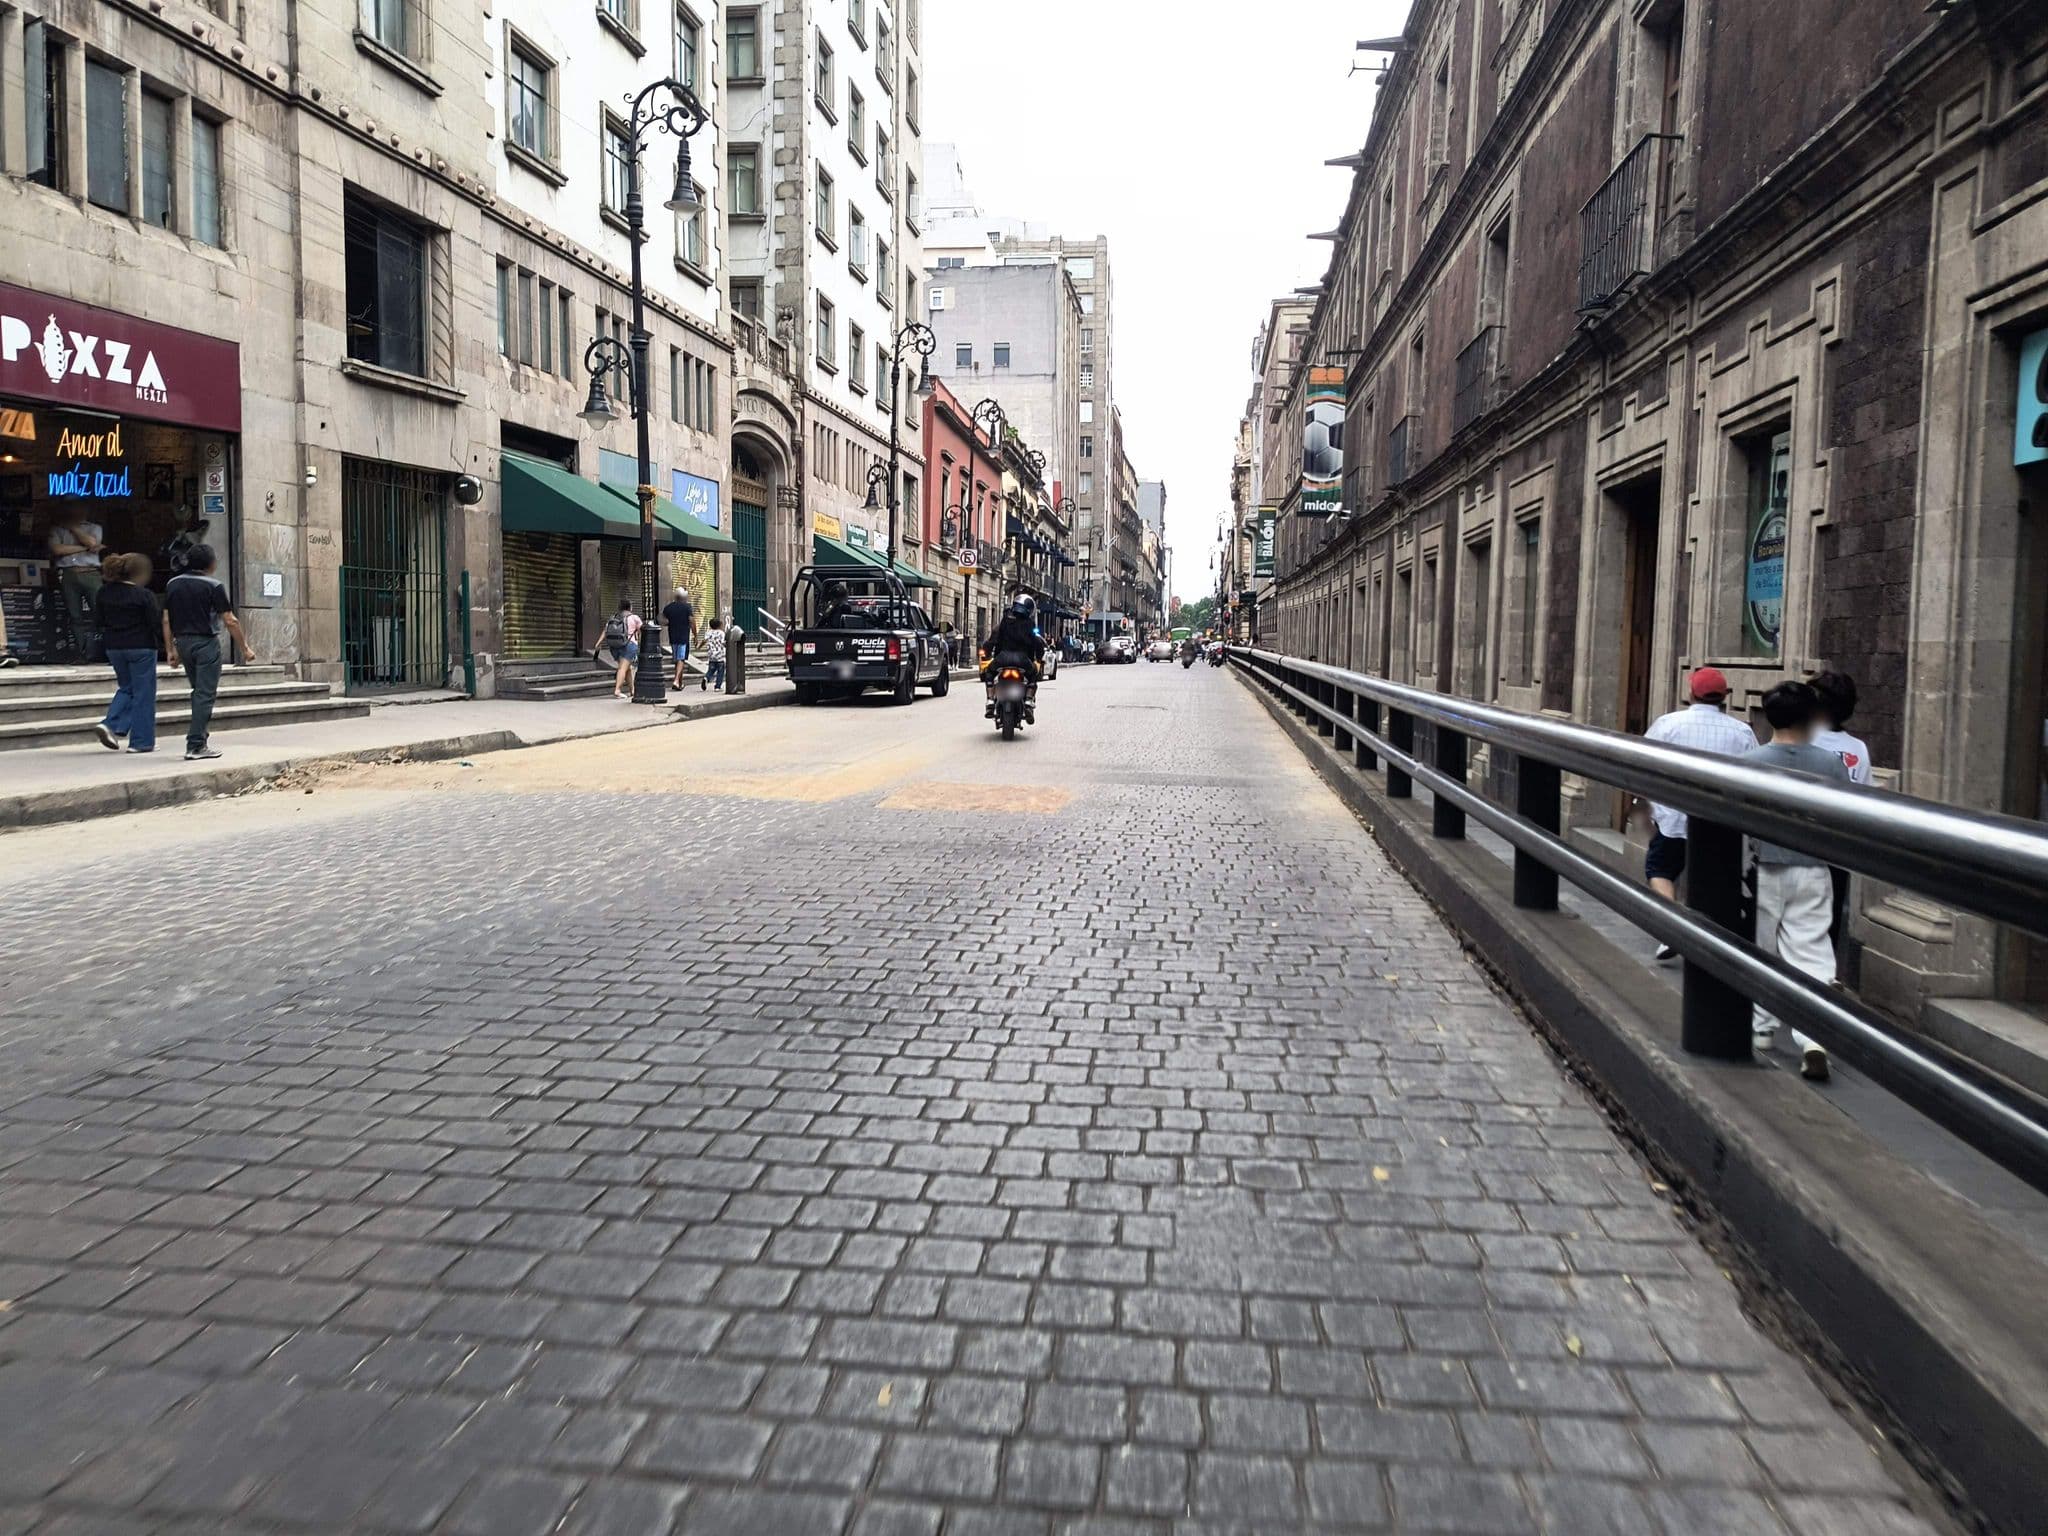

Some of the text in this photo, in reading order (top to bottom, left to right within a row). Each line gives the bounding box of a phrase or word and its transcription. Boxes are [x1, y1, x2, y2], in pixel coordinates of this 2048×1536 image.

[57, 424, 123, 458] Amor al
[49, 462, 132, 497] maíz azul
[851, 637, 886, 646] POLICÍA
